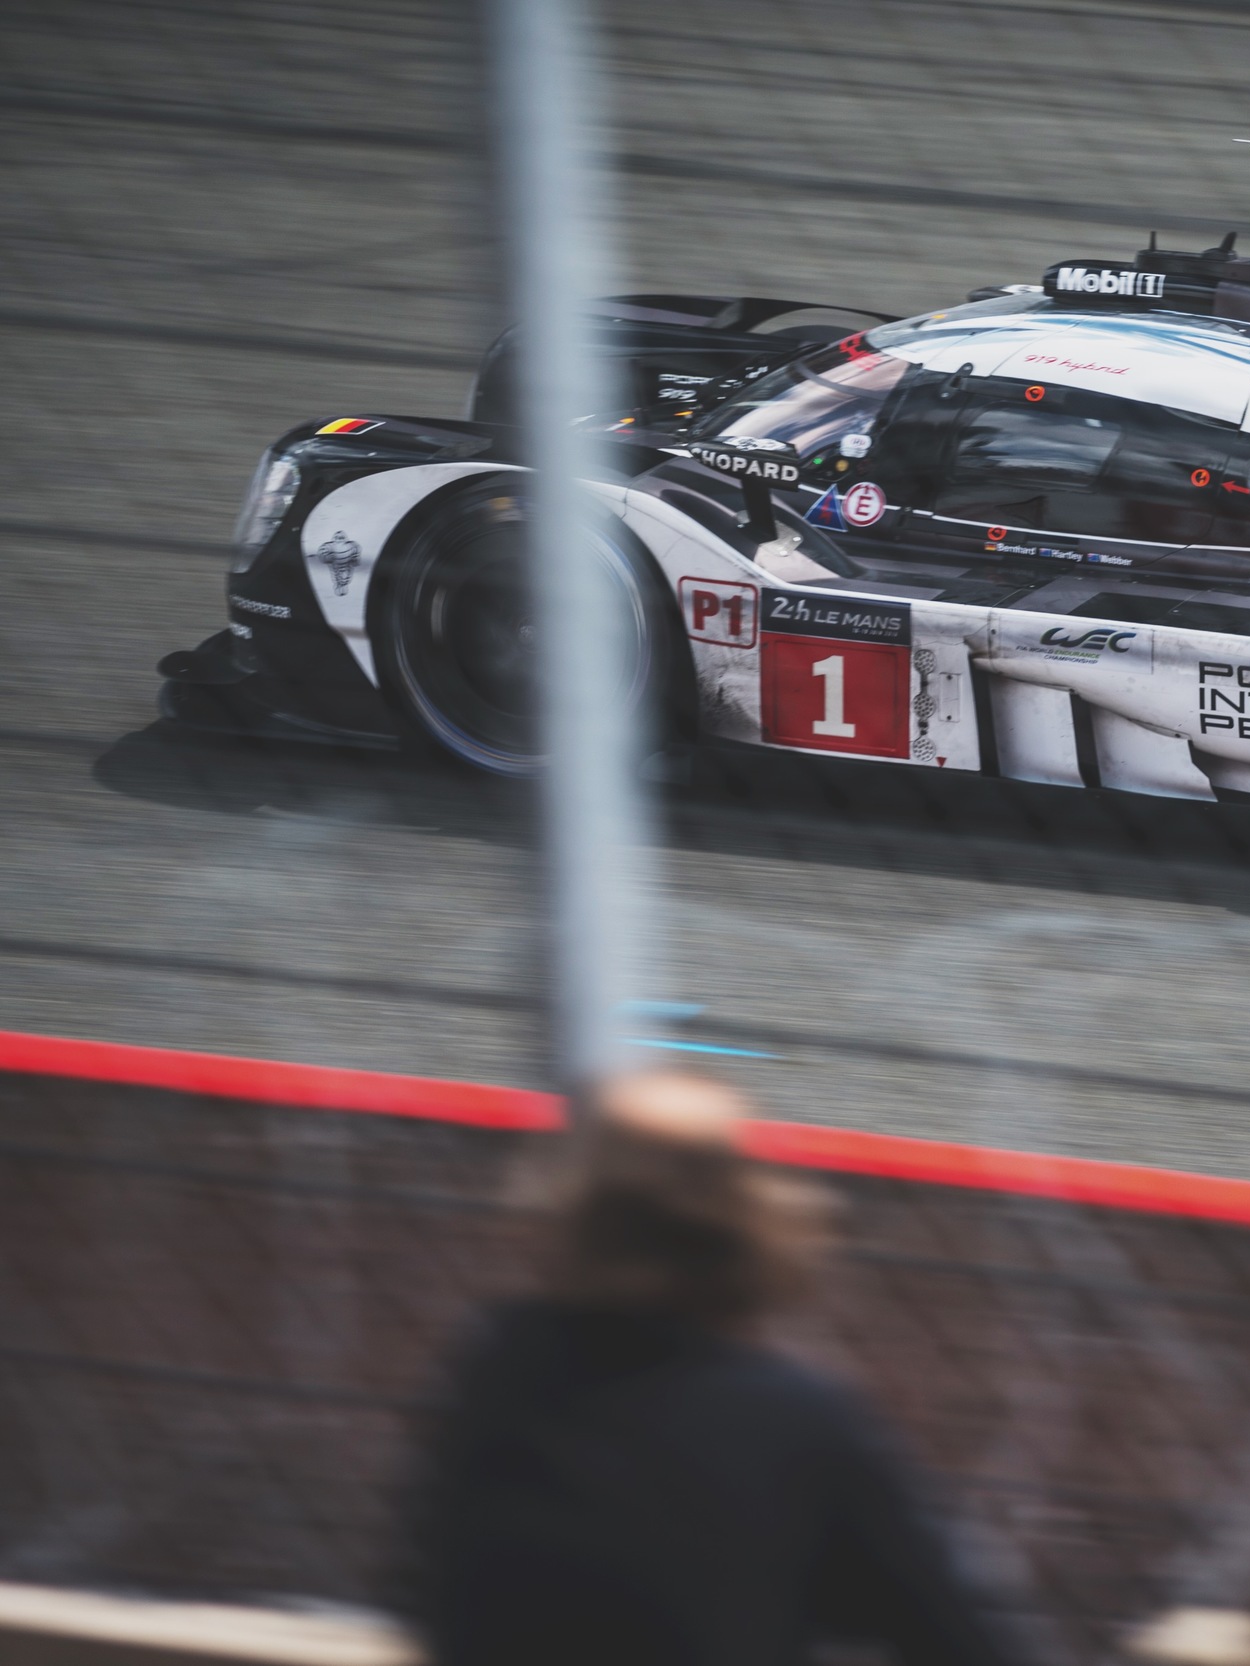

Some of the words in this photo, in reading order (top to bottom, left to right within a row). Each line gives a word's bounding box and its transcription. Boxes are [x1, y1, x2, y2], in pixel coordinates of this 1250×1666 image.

[1057, 267, 1138, 295] Mobil
[1024, 354, 1058, 365] 919
[692, 589, 743, 637] P1
[814, 609, 839, 625] LE
[841, 612, 902, 631] MANS
[1040, 627, 1137, 653] WEC
[812, 655, 856, 738] 1
